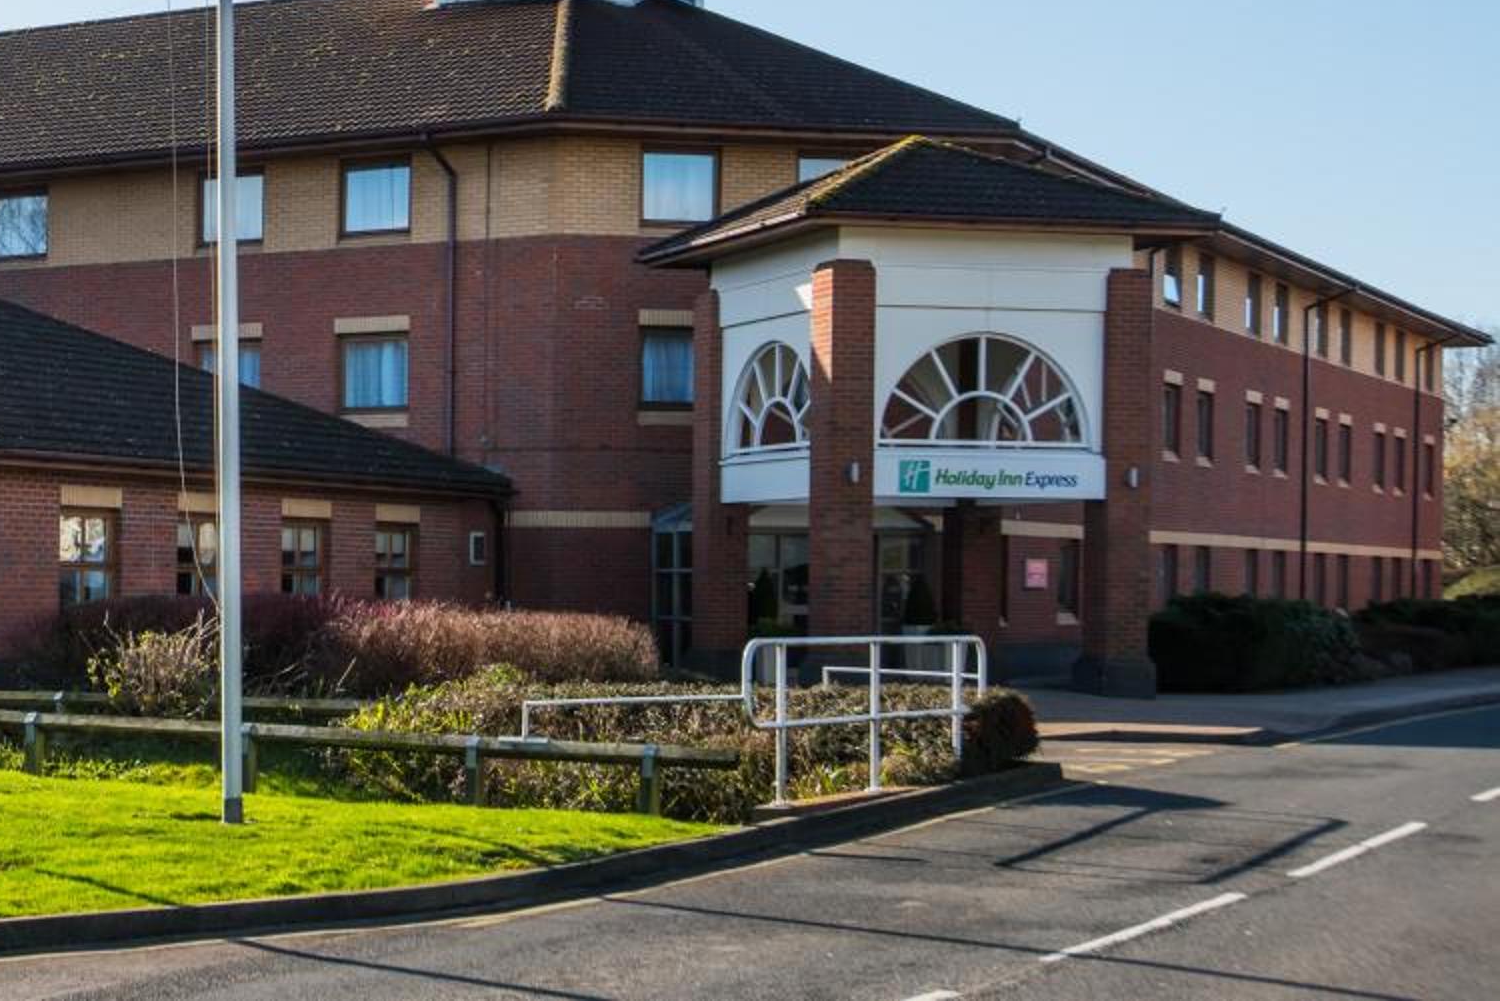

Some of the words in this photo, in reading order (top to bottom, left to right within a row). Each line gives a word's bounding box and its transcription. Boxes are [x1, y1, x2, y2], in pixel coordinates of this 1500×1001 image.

[934, 468, 996, 489] Holiday
[997, 468, 1023, 486] Inn
[1025, 470, 1078, 489] Express
